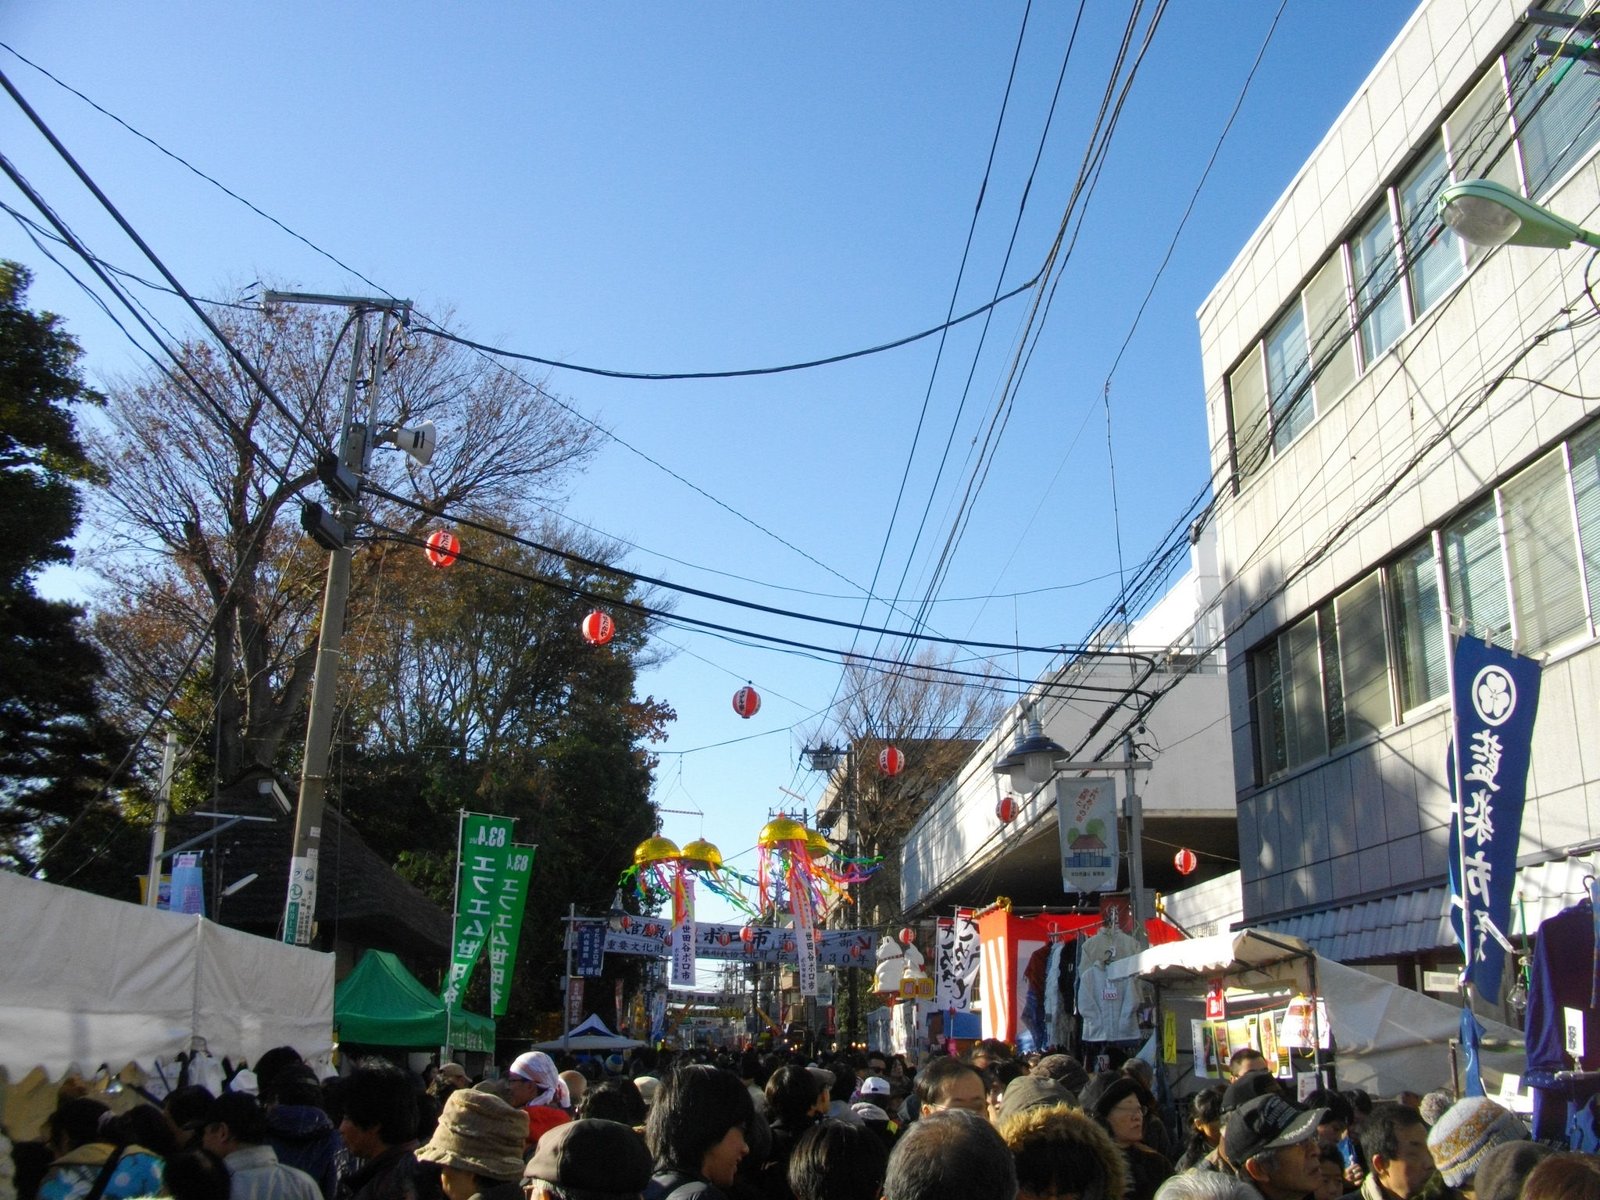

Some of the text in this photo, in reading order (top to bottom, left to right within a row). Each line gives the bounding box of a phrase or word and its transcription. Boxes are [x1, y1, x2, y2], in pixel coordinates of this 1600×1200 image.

[607, 939, 665, 954] 重要文化財
[703, 926, 772, 950] ボロ市
[681, 924, 692, 981] 世田谷ボロ市
[776, 949, 869, 965] 伝430年
[805, 931, 816, 991] 世田谷ボロ市
